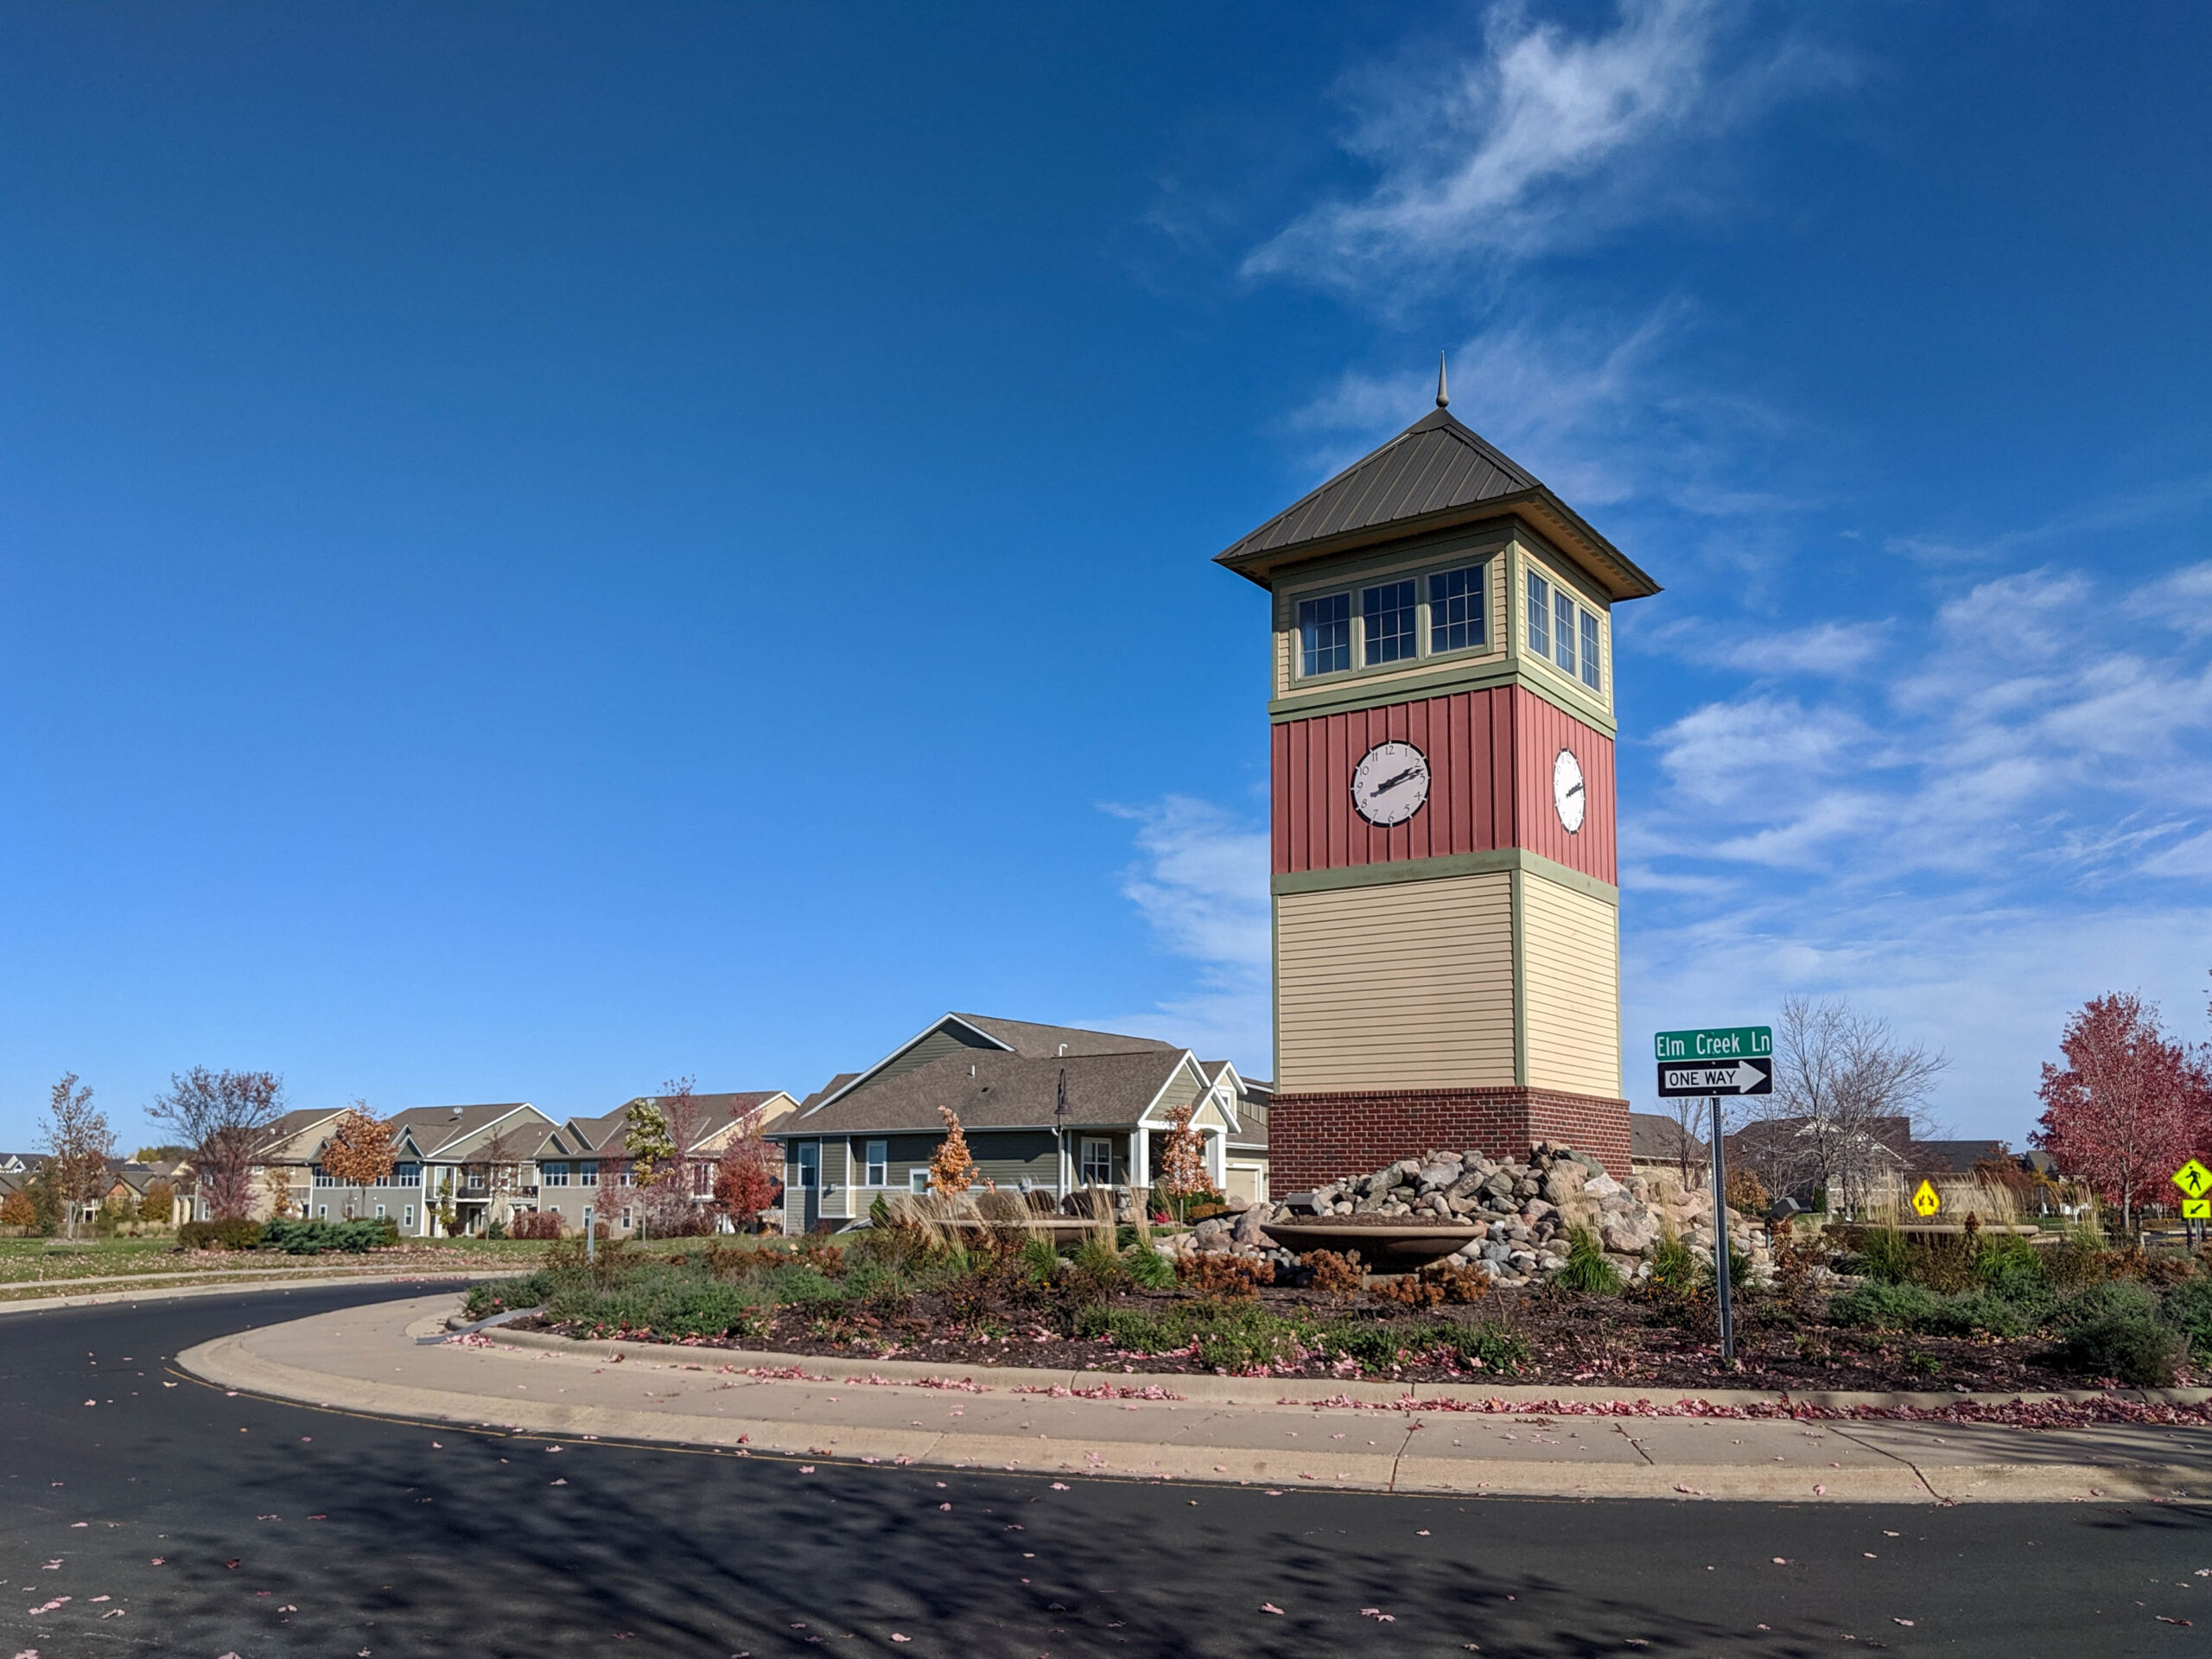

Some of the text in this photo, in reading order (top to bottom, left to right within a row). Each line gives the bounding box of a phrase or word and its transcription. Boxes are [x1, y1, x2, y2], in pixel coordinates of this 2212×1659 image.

[1385, 746, 1395, 755] 12
[1372, 753, 1378, 761] 11
[1414, 758, 1421, 767] 2
[1359, 766, 1369, 775] 10
[1419, 772, 1426, 785] 3
[1357, 782, 1363, 794] 9
[1414, 791, 1422, 801] 4
[1361, 798, 1367, 808] 8
[1373, 809, 1378, 819] 7
[1403, 804, 1410, 816] 5
[1388, 810, 1395, 823] 6
[1656, 1031, 1770, 1057] Elm Creek Ln
[1669, 1070, 1737, 1086] ONE WAY
